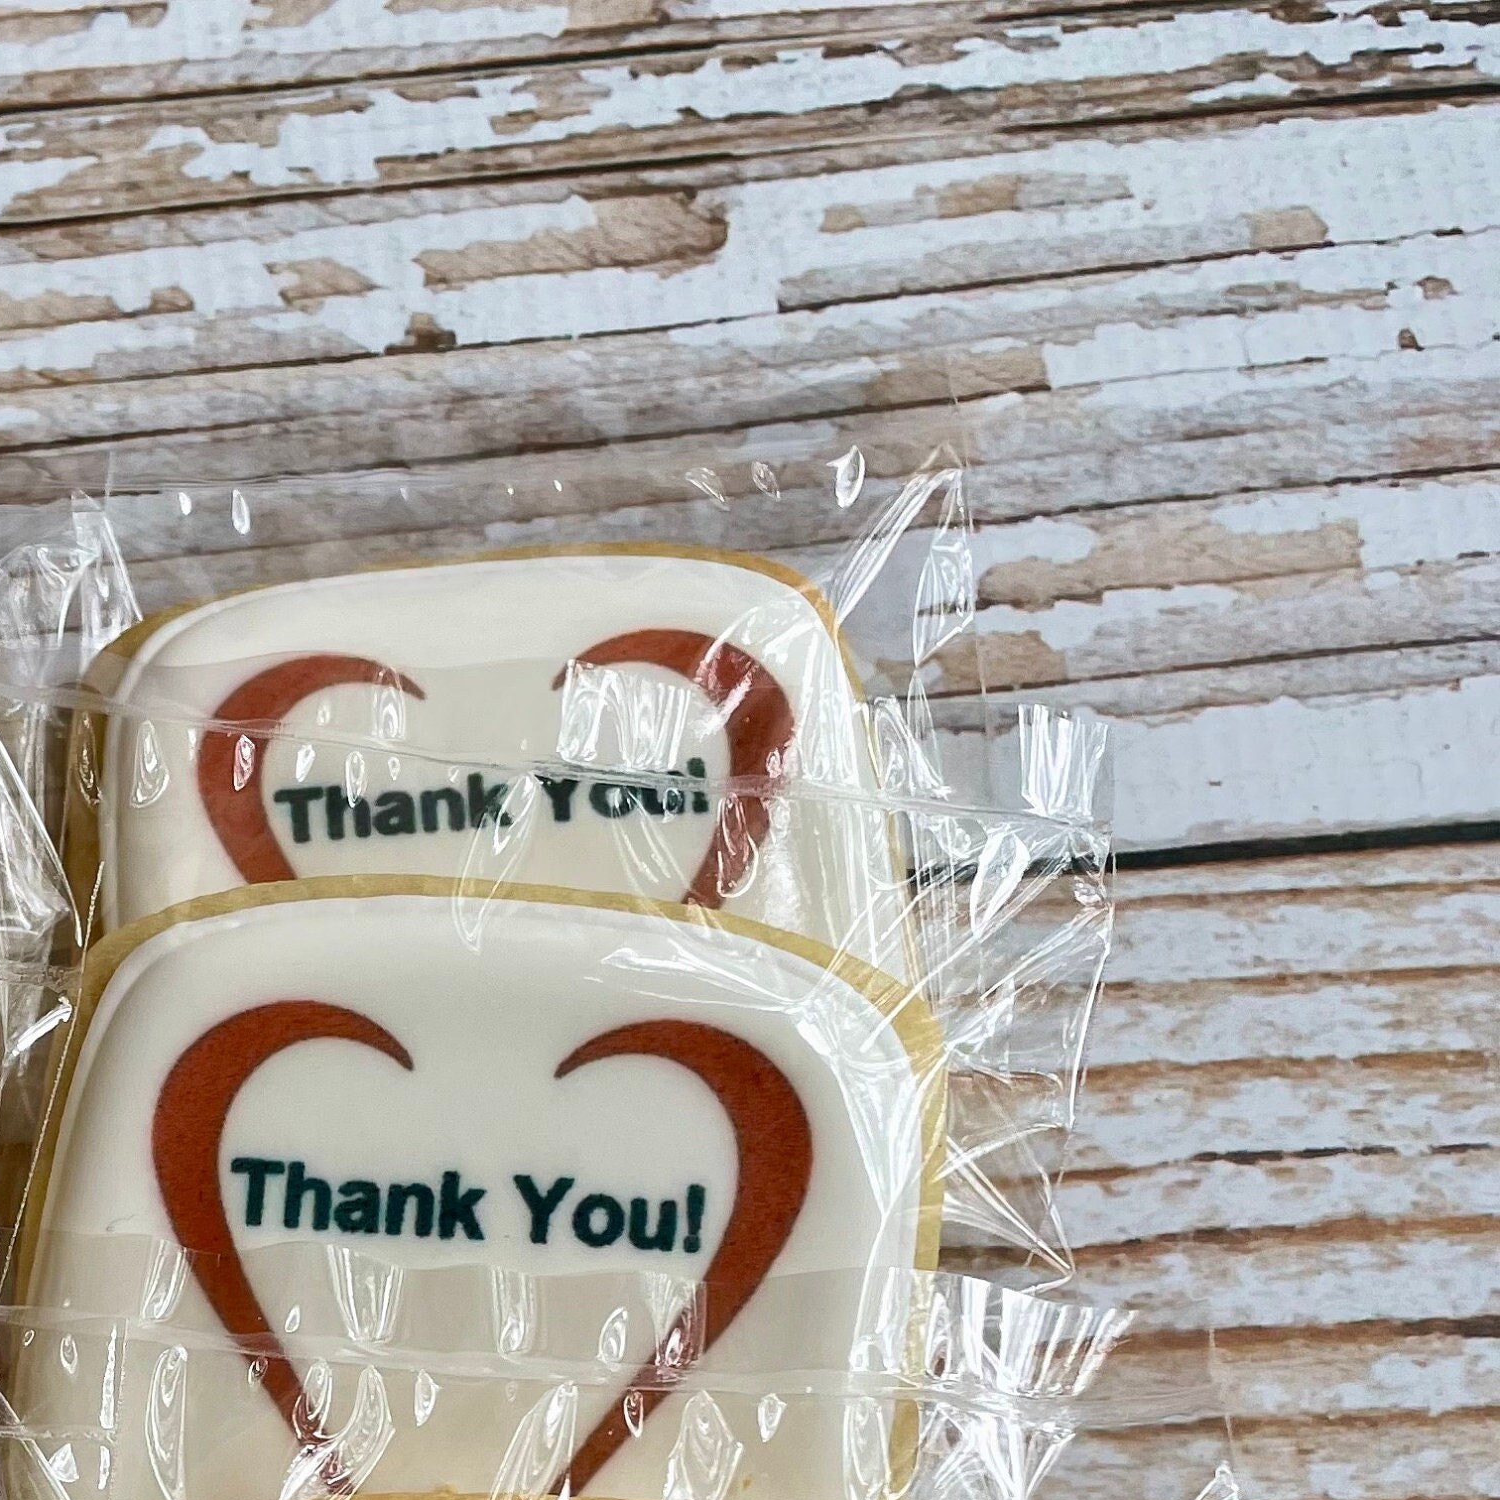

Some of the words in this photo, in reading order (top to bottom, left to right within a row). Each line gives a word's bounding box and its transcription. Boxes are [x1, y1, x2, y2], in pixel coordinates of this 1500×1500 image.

[274, 771, 509, 844] Thank
[534, 756, 711, 825] You!
[229, 1156, 488, 1242] Thank
[512, 1174, 707, 1255] You!
